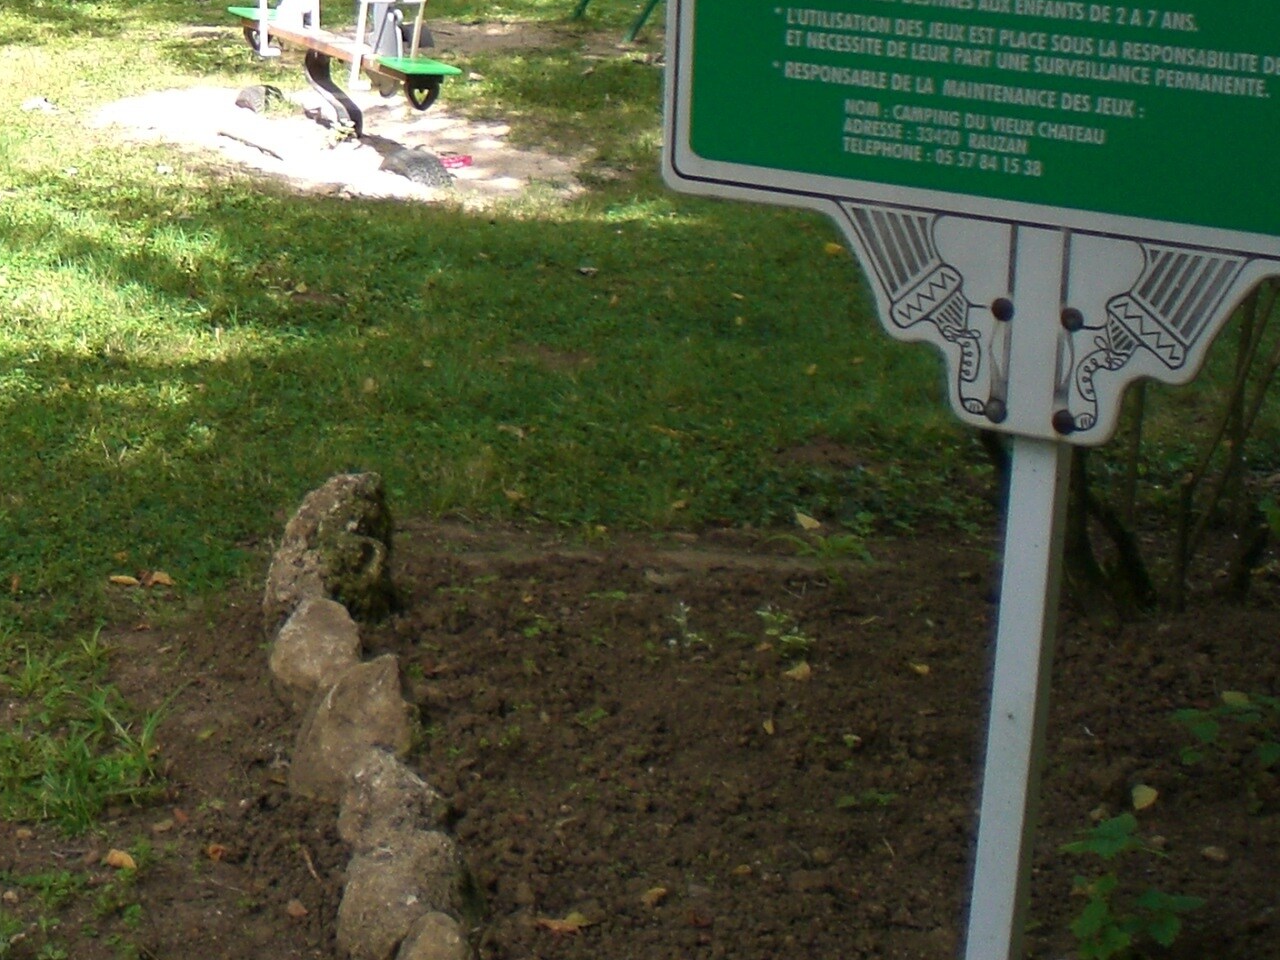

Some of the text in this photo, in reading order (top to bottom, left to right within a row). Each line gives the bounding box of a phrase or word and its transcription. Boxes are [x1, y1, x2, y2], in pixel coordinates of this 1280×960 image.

[787, 8, 891, 33] L'UTILISATION
[895, 20, 923, 37] DES
[927, 21, 965, 41] JEUX
[969, 26, 995, 44] EST
[1000, 30, 1047, 50] PLACE
[1051, 35, 1094, 54] SOUS
[1098, 40, 1118, 58] LA
[1123, 41, 1258, 73] RESPONSABILITE
[1090, 4, 1111, 23] DE
[1116, 7, 1126, 24] 2
[1130, 9, 1142, 26] A
[1147, 10, 1158, 27] 7
[1161, 11, 1199, 31] ANS.
[785, 30, 1271, 98] ET NECESSITE DE LEUR PART UNE SURVEILLANCE PERMANENTE.
[785, 62, 887, 89] RESPONSABLE
[891, 74, 911, 92] DE
[916, 76, 935, 94] LA
[942, 79, 1056, 108] MAINTENANCE
[1060, 92, 1091, 112] DES
[1095, 96, 1135, 117] JEUX
[843, 118, 904, 139] ADRESSE
[916, 126, 960, 146] 33420
[968, 132, 1029, 154] RAUZAN
[844, 99, 880, 117] NOM
[893, 104, 961, 127] CAMPING
[965, 113, 987, 130] DU
[991, 116, 1035, 136] VIEUX
[1038, 120, 1106, 145] CHATEAU
[843, 136, 922, 161] TELEPHONE
[935, 148, 953, 165] 05
[957, 152, 976, 167] 57
[979, 154, 998, 170] 84
[1002, 157, 1019, 174] 15
[1023, 159, 1044, 177] 38
